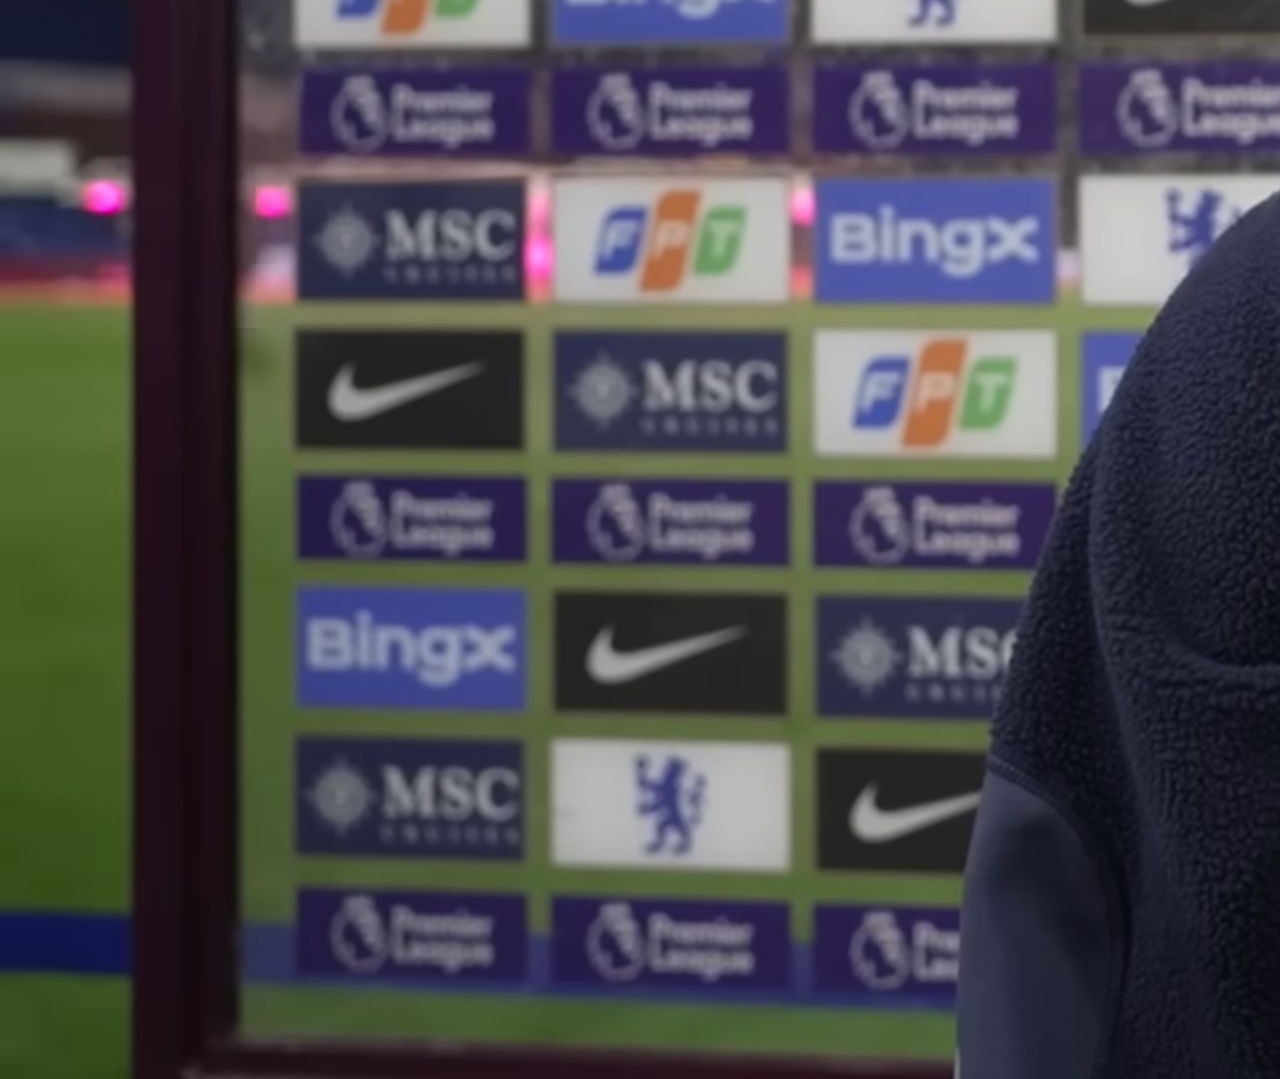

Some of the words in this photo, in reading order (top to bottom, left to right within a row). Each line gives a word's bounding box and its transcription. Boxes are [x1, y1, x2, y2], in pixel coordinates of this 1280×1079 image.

[391, 84, 492, 115] Premier
[649, 82, 751, 113] Premier
[912, 80, 1017, 112] Premier
[391, 115, 494, 147] League
[649, 112, 753, 147] League
[912, 111, 1018, 146] League
[385, 207, 516, 263] MSC
[641, 358, 778, 413] MSC
[390, 491, 492, 522] Premier
[648, 494, 752, 525] Premier
[913, 496, 1018, 529] Premier
[390, 522, 493, 556] League
[648, 525, 753, 558] League
[913, 529, 1019, 561] League
[381, 763, 520, 822] MSC
[391, 906, 492, 939] Premier
[649, 914, 752, 948] Premier
[391, 937, 493, 972] League
[649, 946, 754, 981] League
